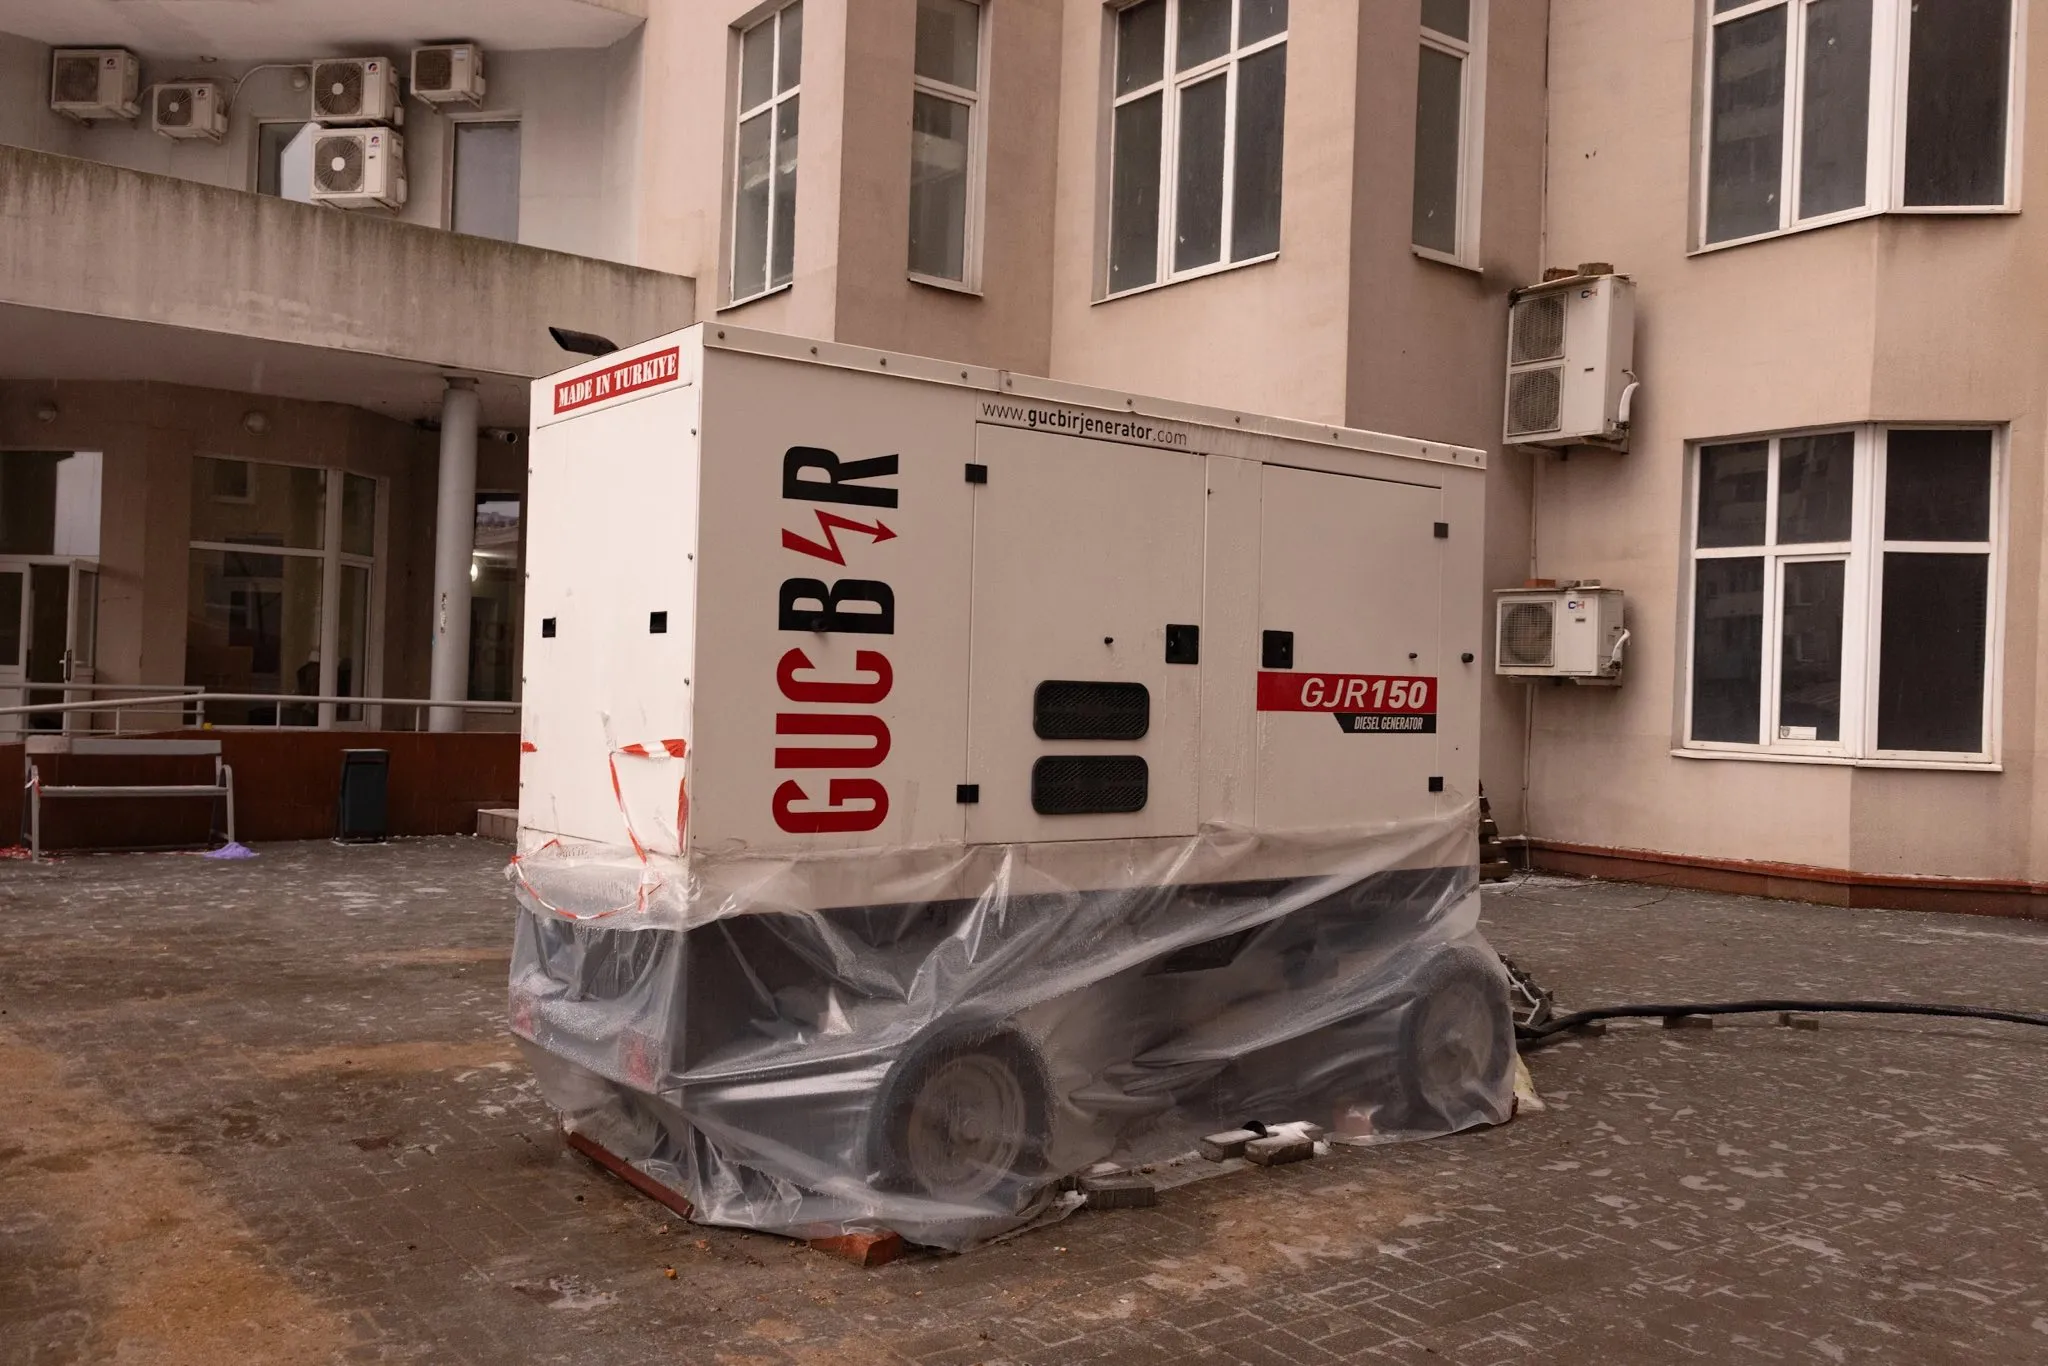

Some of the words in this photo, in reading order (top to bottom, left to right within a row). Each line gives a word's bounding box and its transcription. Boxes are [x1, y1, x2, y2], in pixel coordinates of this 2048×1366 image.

[558, 378, 593, 408] MADE
[595, 373, 611, 397] IN
[614, 353, 677, 391] TURKIYE
[982, 402, 1188, 446] www.gucbirjenerator.com
[1568, 601, 1585, 610] CH
[1354, 716, 1380, 730] DIESEL
[1381, 716, 1424, 731] GENERATOR
